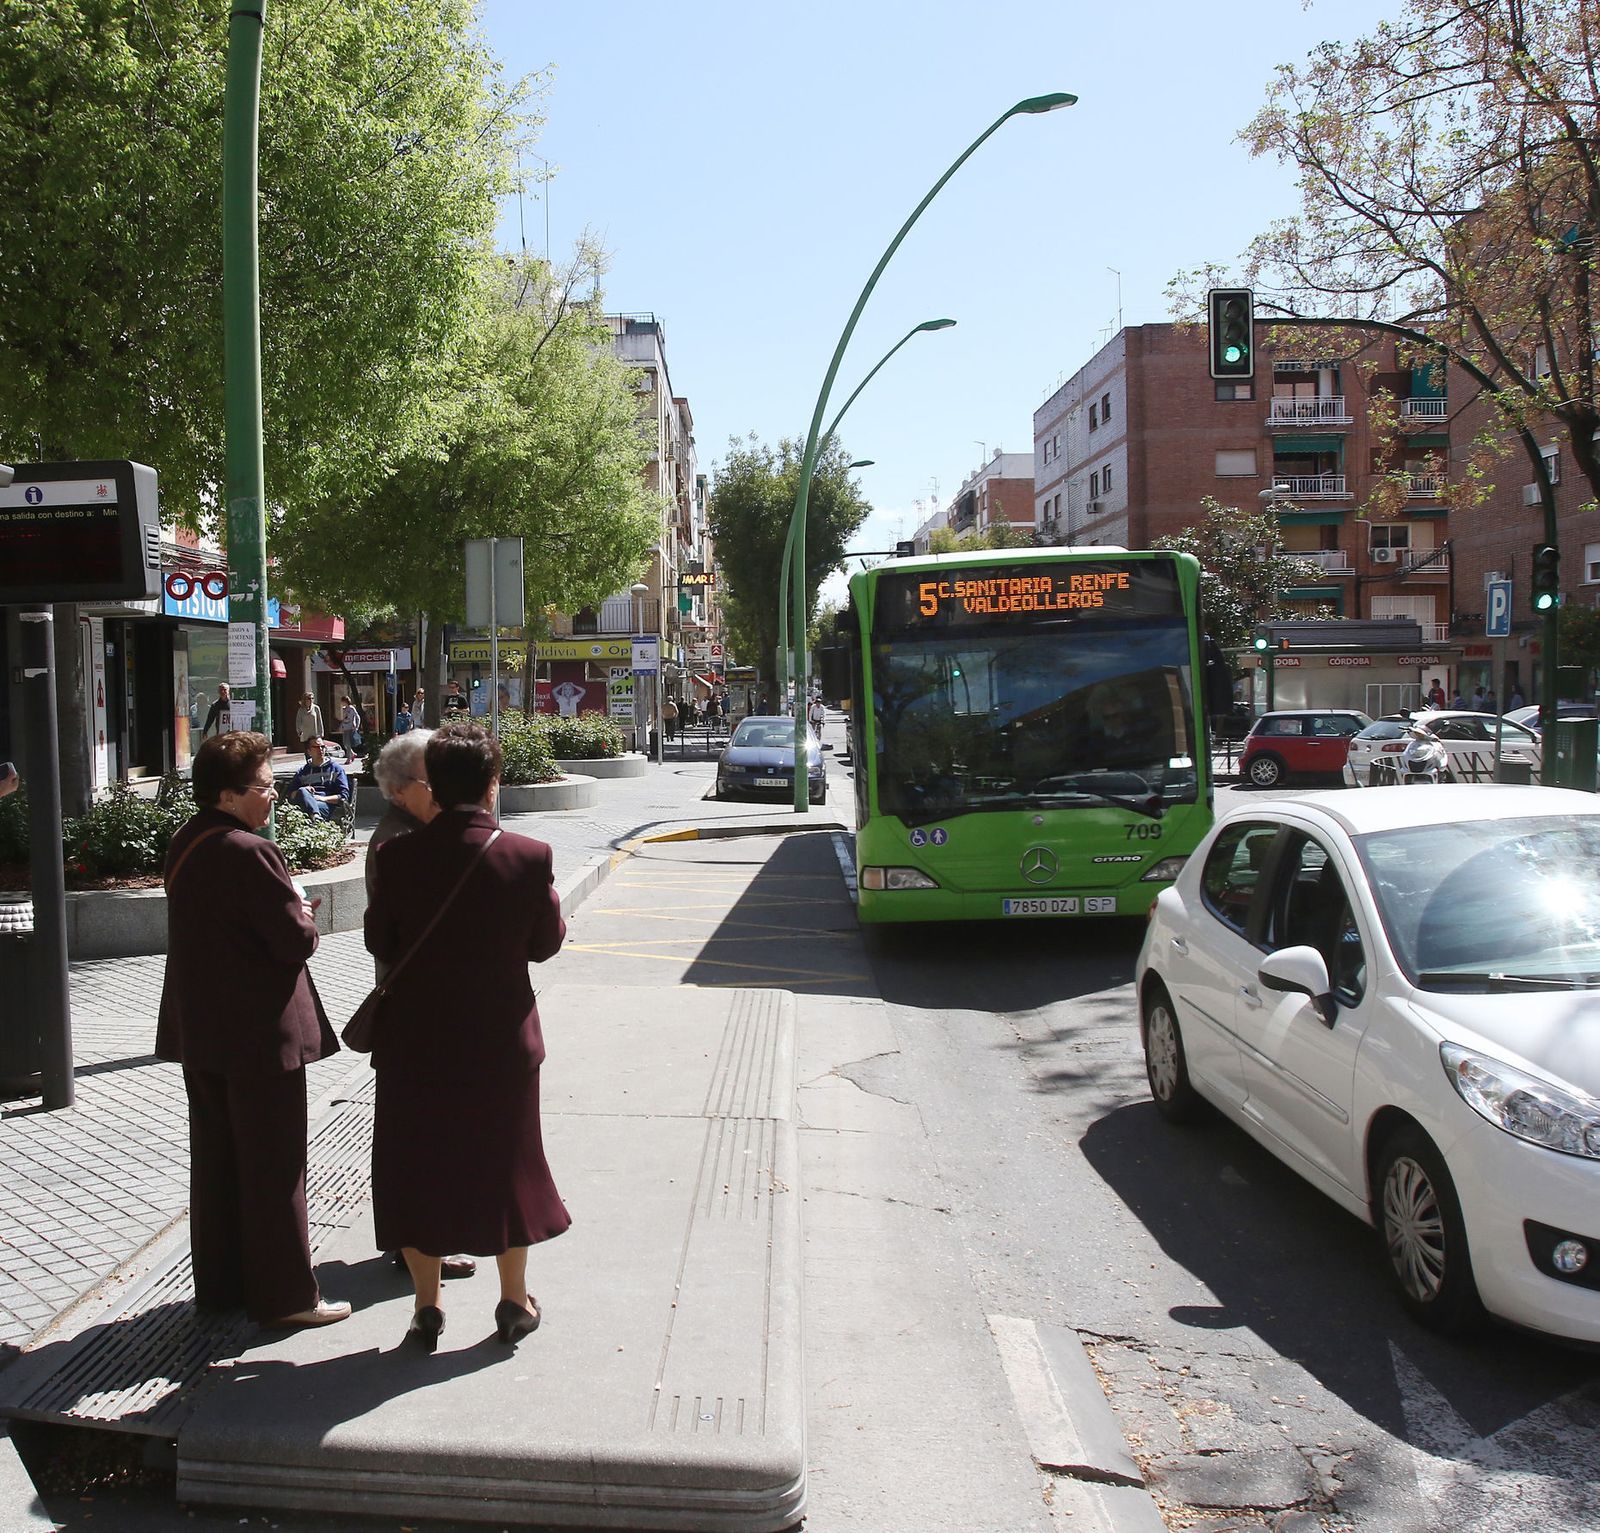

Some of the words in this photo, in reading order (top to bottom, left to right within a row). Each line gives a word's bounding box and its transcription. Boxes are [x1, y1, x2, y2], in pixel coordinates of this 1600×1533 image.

[12, 511, 35, 520] salida
[38, 511, 52, 519] con
[54, 509, 84, 518] destino
[938, 576, 1052, 598] C.SANITARIA
[1070, 572, 1130, 592] RENFE
[919, 582, 939, 617] 5
[964, 591, 1104, 614] VALDEOLLEROS
[1491, 588, 1507, 630] P
[453, 646, 520, 659] farmcia
[1329, 656, 1370, 666] CÓRDOBA
[1398, 656, 1440, 665] CÓRDOBA
[610, 685, 623, 695] 12
[625, 685, 633, 695] H
[1124, 823, 1163, 841] 709
[1094, 855, 1142, 863] CITARO
[1013, 901, 1047, 914] 7850
[1051, 900, 1077, 912] DZJ
